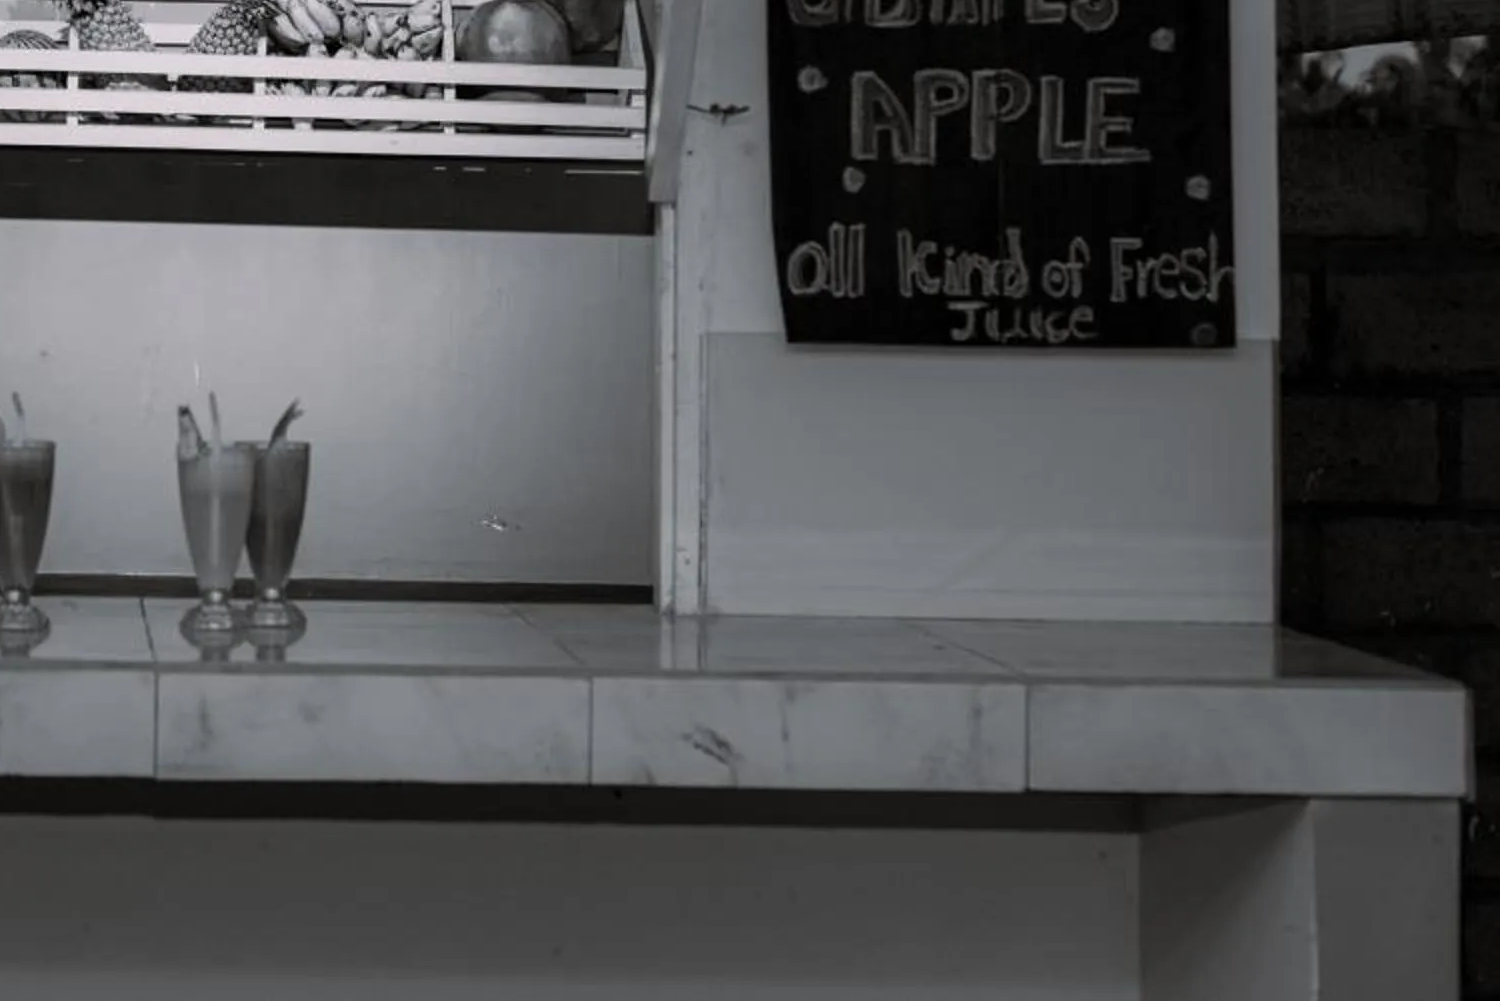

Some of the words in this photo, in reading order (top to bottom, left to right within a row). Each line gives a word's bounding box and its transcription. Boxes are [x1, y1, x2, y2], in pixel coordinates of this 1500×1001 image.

[848, 67, 1153, 167] APPLE
[1041, 235, 1092, 299] of
[1108, 229, 1236, 303] Fresh
